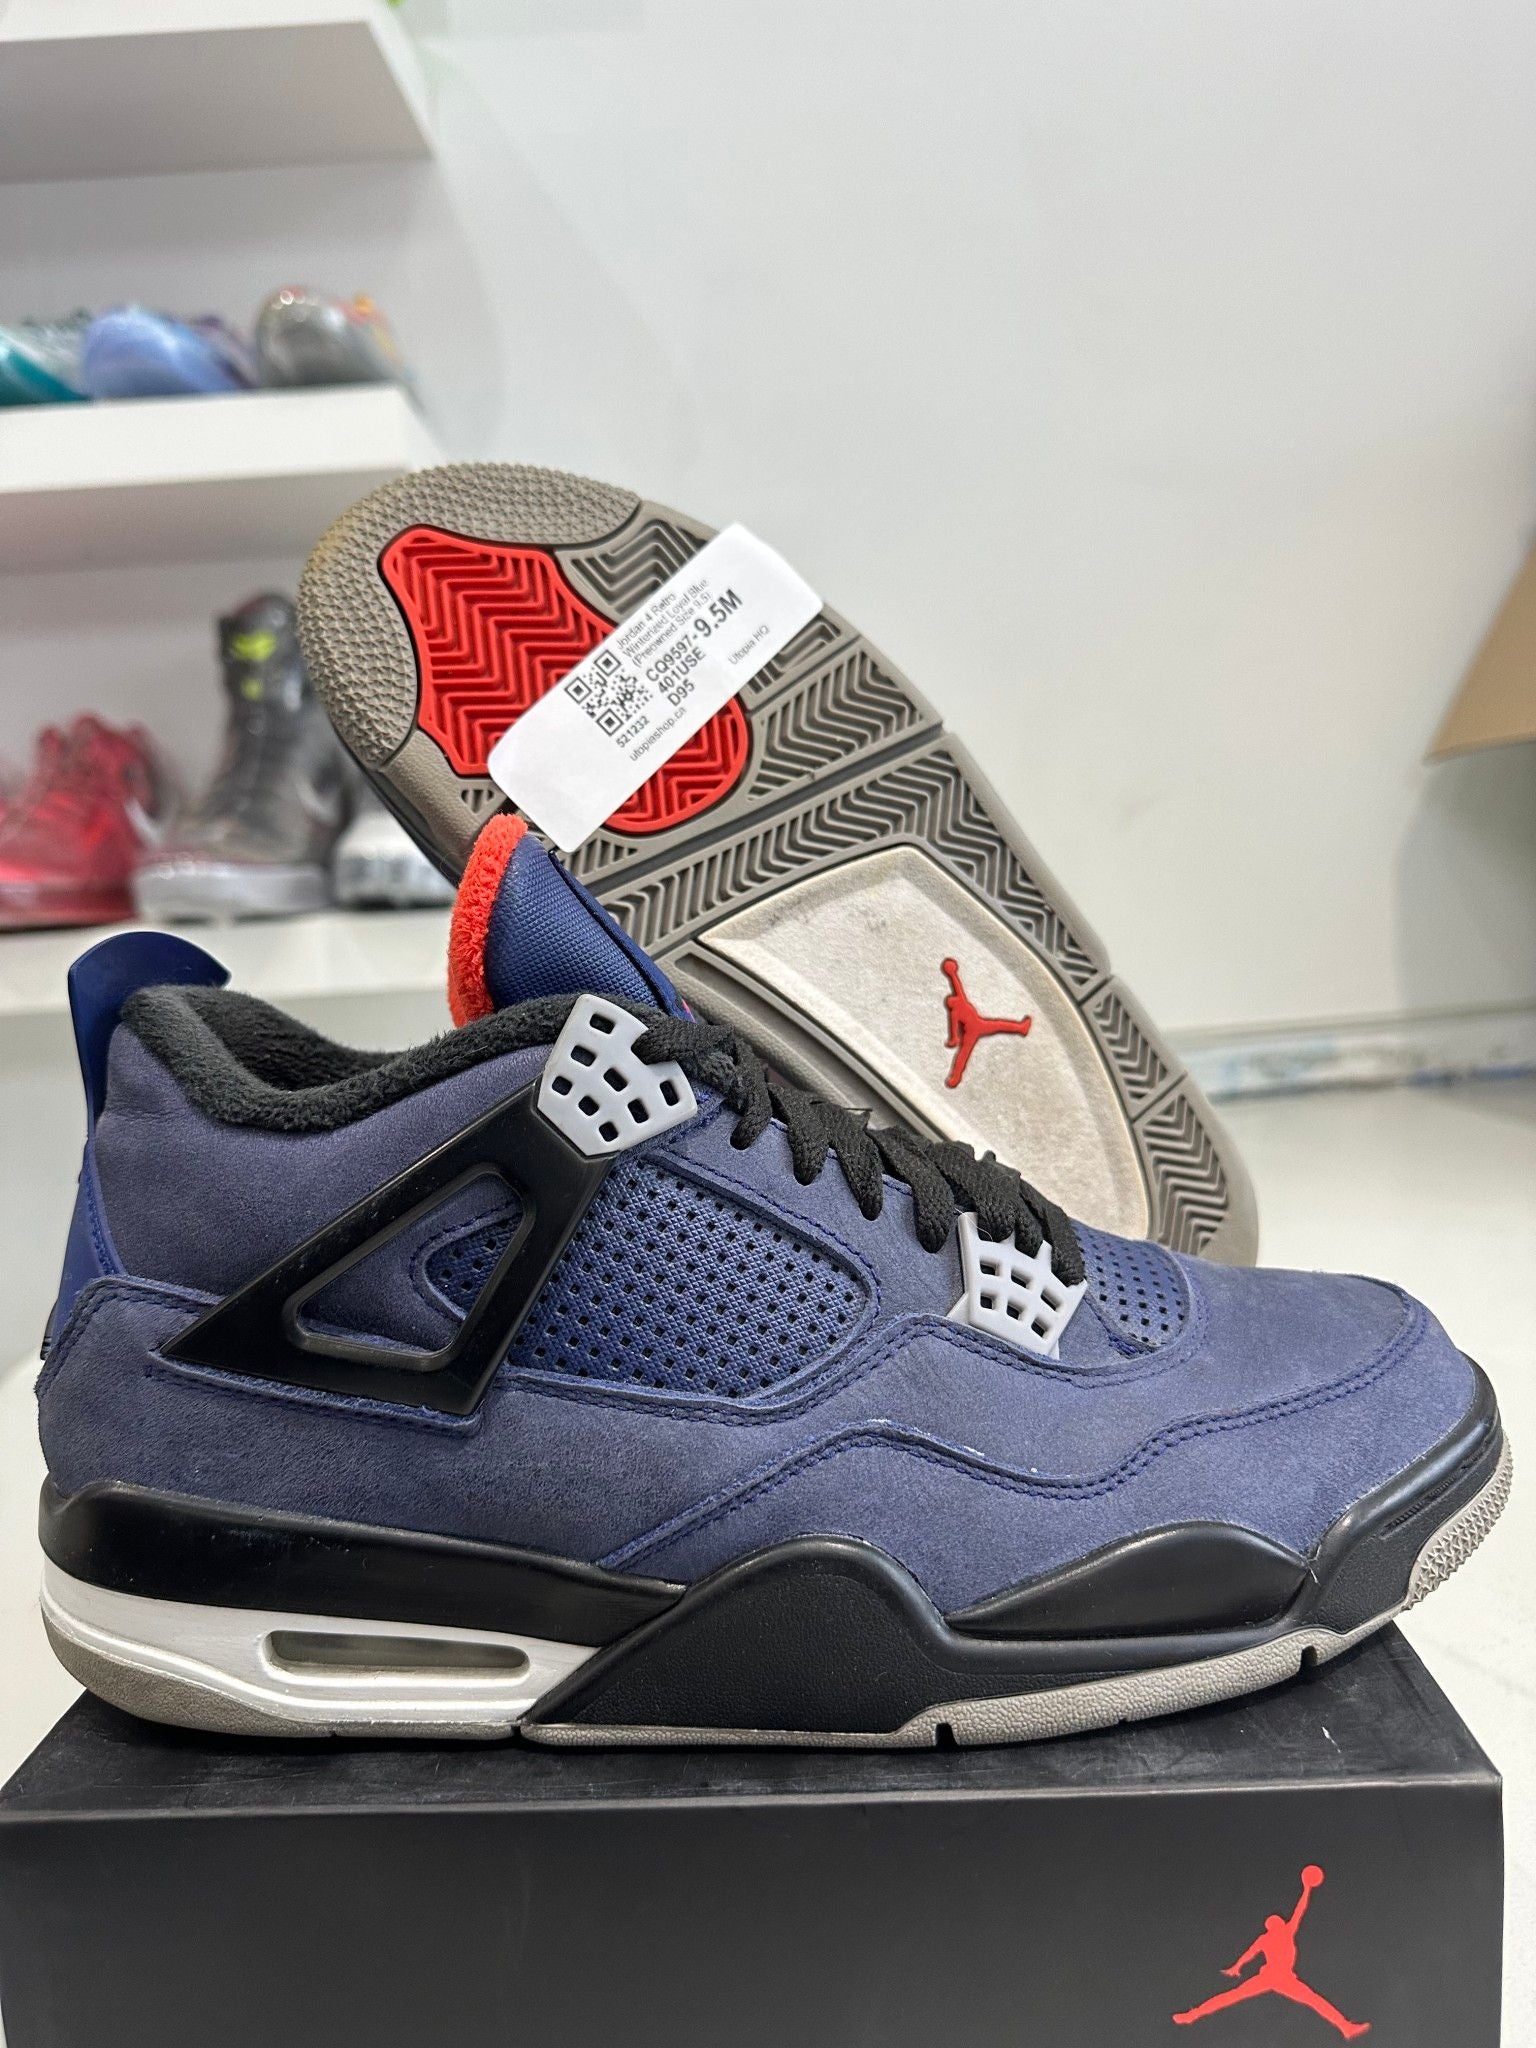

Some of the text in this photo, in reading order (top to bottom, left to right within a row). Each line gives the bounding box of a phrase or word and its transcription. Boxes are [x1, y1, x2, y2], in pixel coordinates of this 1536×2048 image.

[616, 593, 676, 650] Jordan 4 Retro
[621, 615, 669, 658] Winterized
[687, 579, 707, 599] Blue
[645, 588, 744, 682] CQ9597- 9.5M
[675, 607, 695, 626] Size
[728, 624, 770, 665] Utopia HQ
[657, 645, 707, 694] 401USE
[666, 677, 696, 707] D95
[615, 715, 651, 749] 521232
[629, 706, 687, 762] utopiashop.ca
